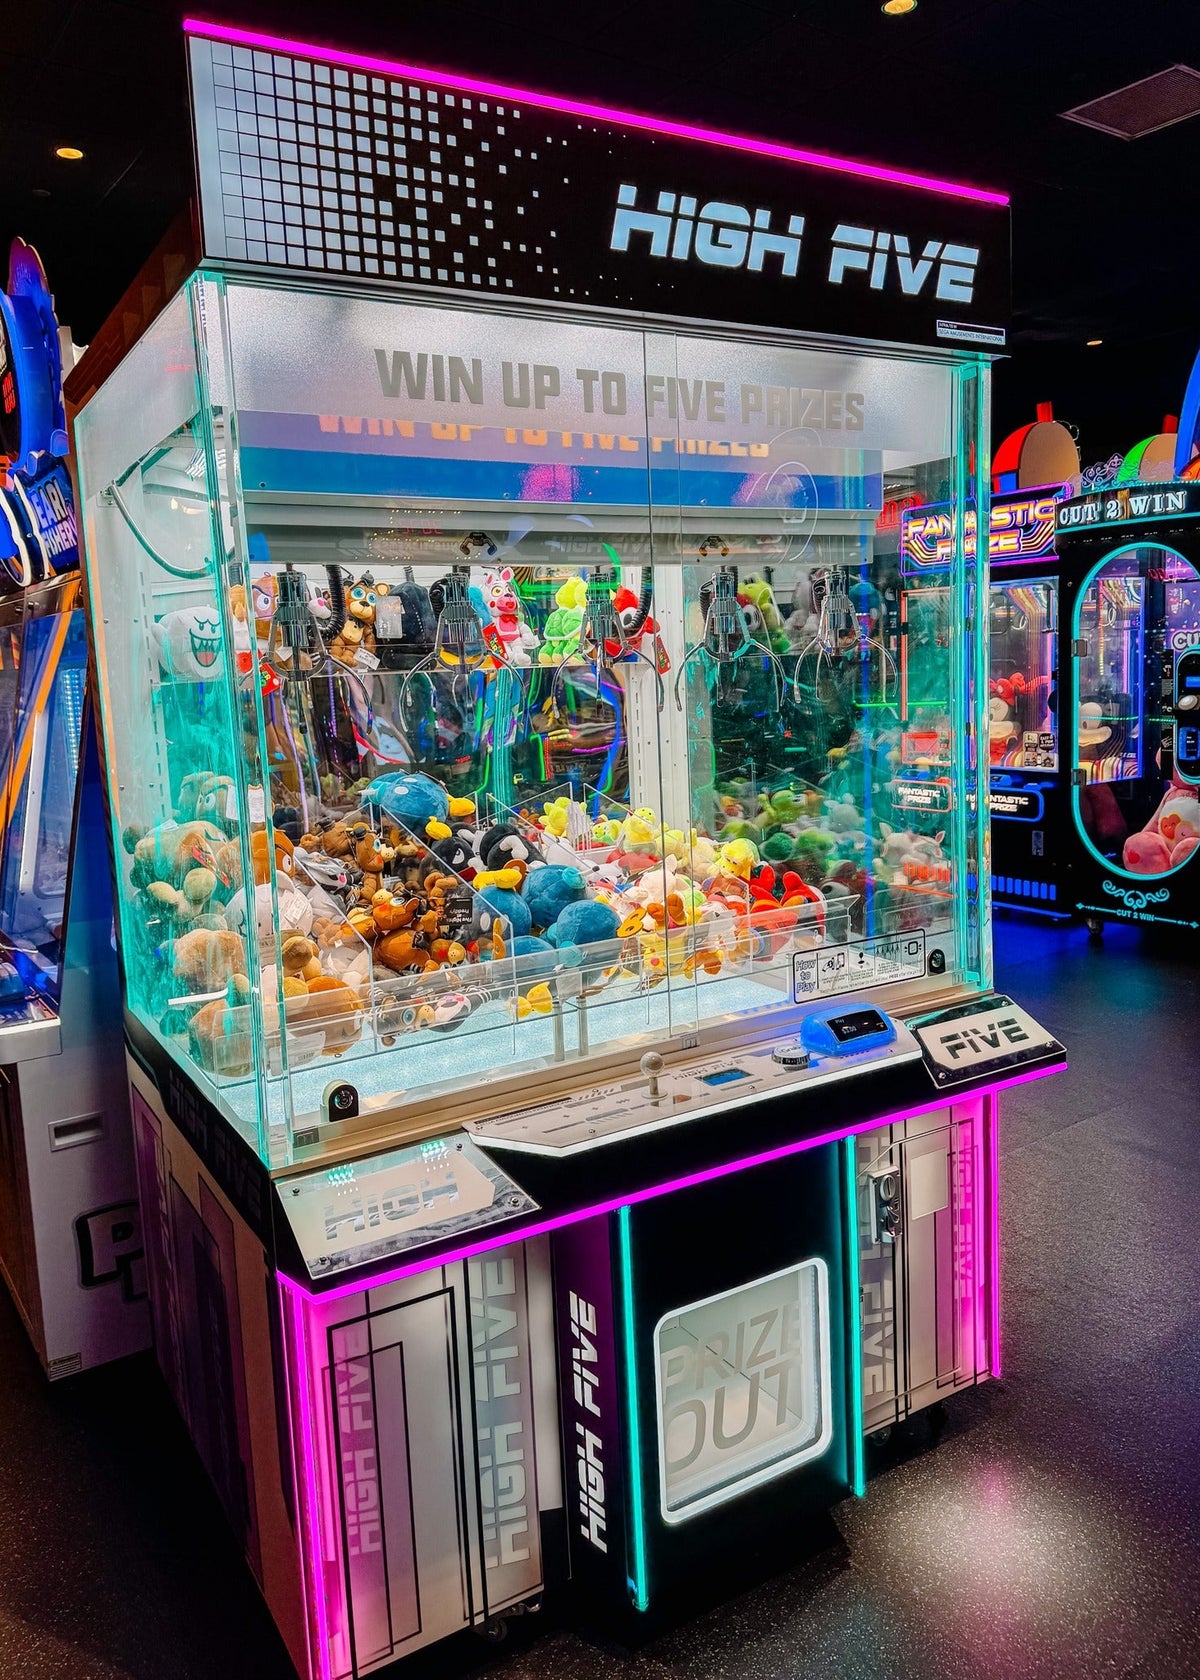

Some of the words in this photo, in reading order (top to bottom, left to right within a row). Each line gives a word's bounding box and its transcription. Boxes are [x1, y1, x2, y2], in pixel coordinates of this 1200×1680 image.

[611, 184, 804, 276] HIGH
[828, 224, 980, 303] FIVE
[375, 348, 483, 404] WIN
[503, 360, 560, 408] UP
[577, 369, 626, 416] TO
[647, 378, 726, 423] FIVE
[742, 385, 865, 431] PRIZES
[1060, 502, 1100, 525] CUT
[1106, 500, 1121, 520] 2
[1129, 491, 1187, 516] WIN
[1172, 631, 1200, 651] CU
[1116, 909, 1132, 918] CUT
[1140, 912, 1155, 921] WIN
[796, 960, 816, 971] How
[796, 981, 815, 993] Play
[800, 970, 811, 980] to
[940, 1017, 1030, 1061] FIVE
[325, 1171, 460, 1241] HIGH
[472, 1256, 522, 1402] FIVE
[568, 1290, 601, 1418] FIVE
[340, 1328, 374, 1435] FIVE
[667, 1358, 797, 1475] OUT
[342, 1438, 382, 1556] HIGH
[478, 1420, 532, 1570] HIGH
[570, 1422, 607, 1554] HIGH
